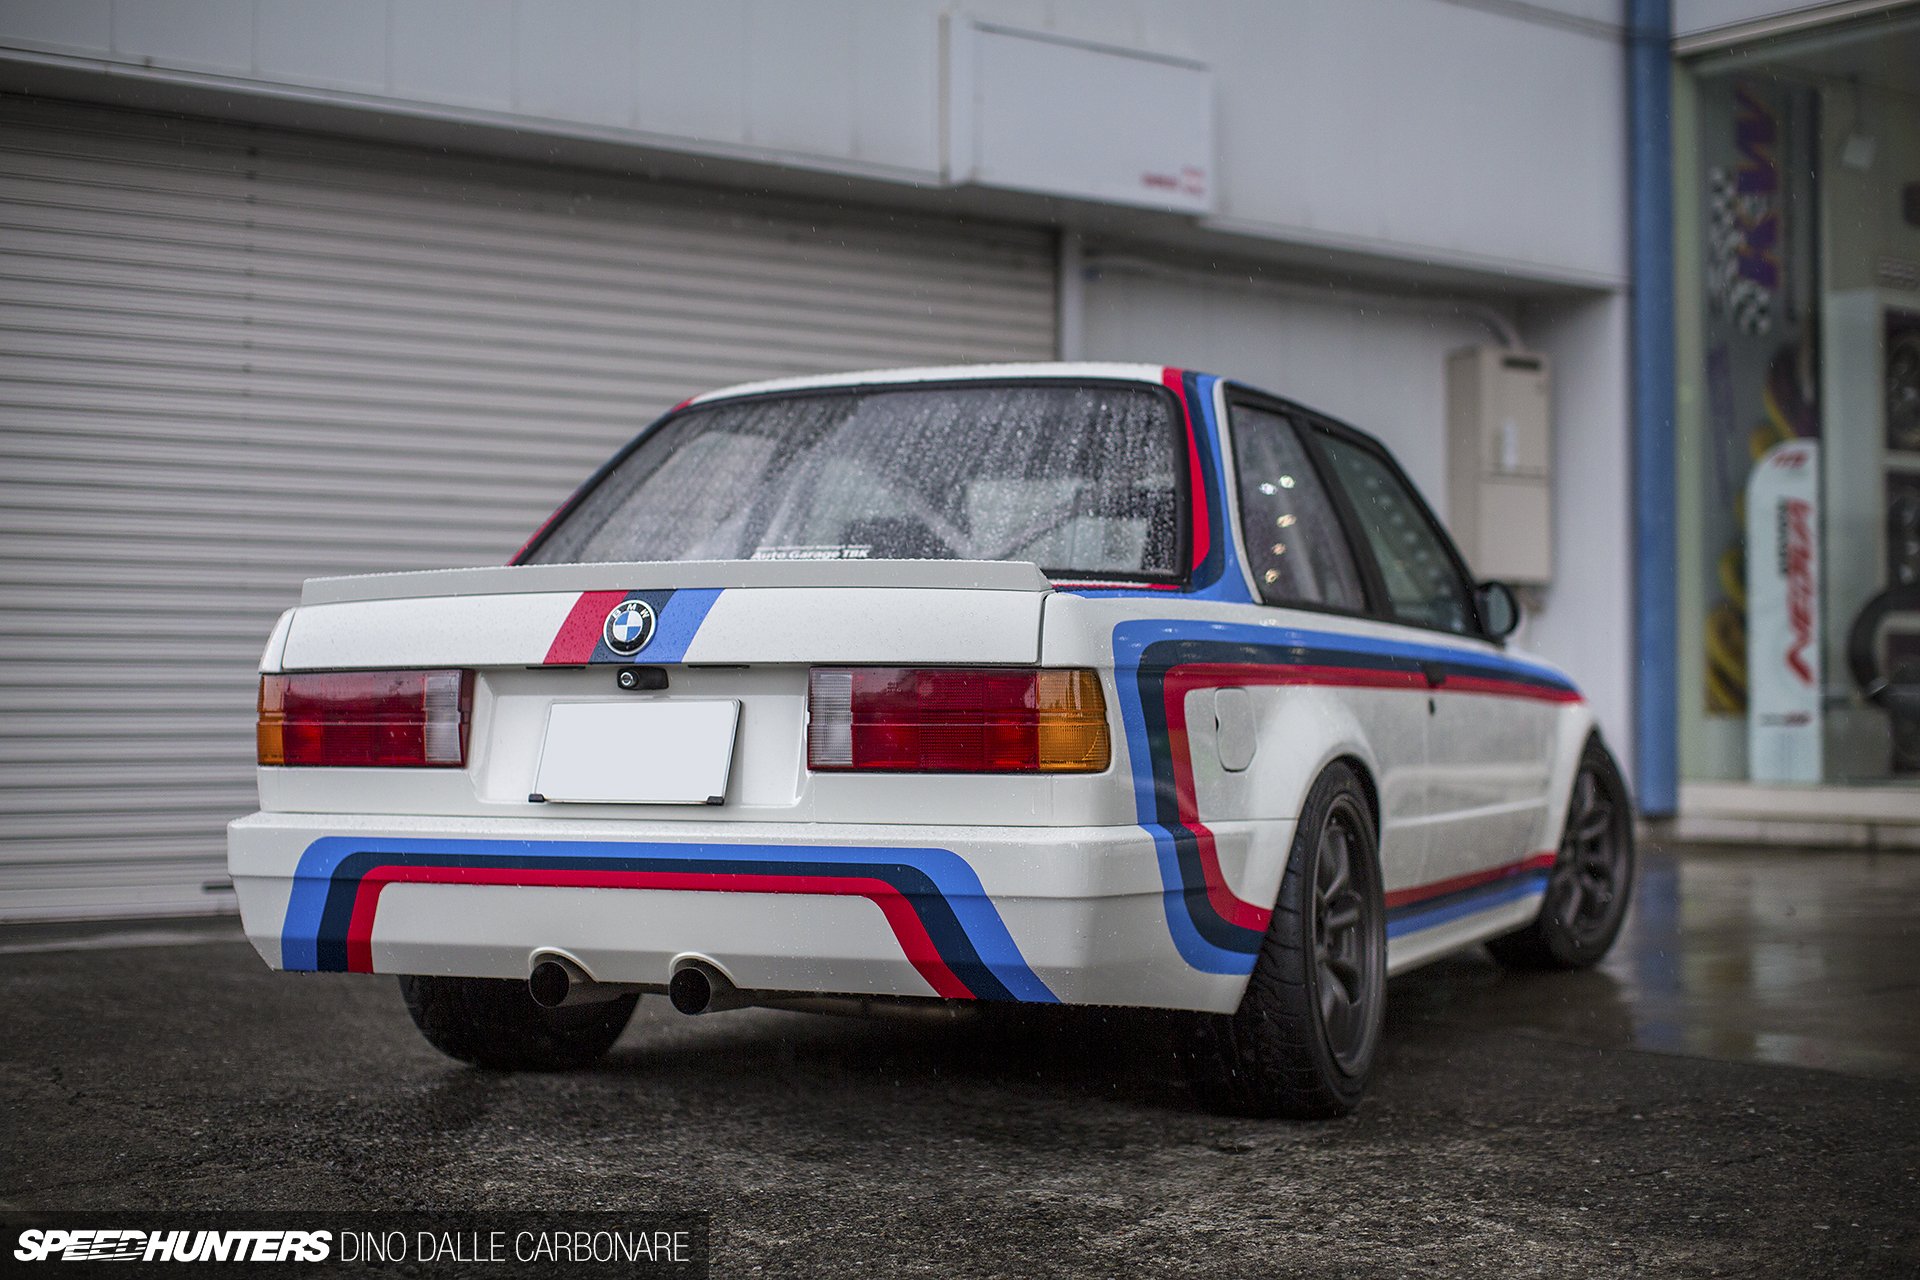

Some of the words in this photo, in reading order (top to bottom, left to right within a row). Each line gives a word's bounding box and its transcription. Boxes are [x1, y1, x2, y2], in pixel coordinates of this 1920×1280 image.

[752, 551, 786, 559] Auto
[789, 550, 841, 559] Garage
[842, 549, 869, 558] TBK
[612, 604, 650, 618] BMW
